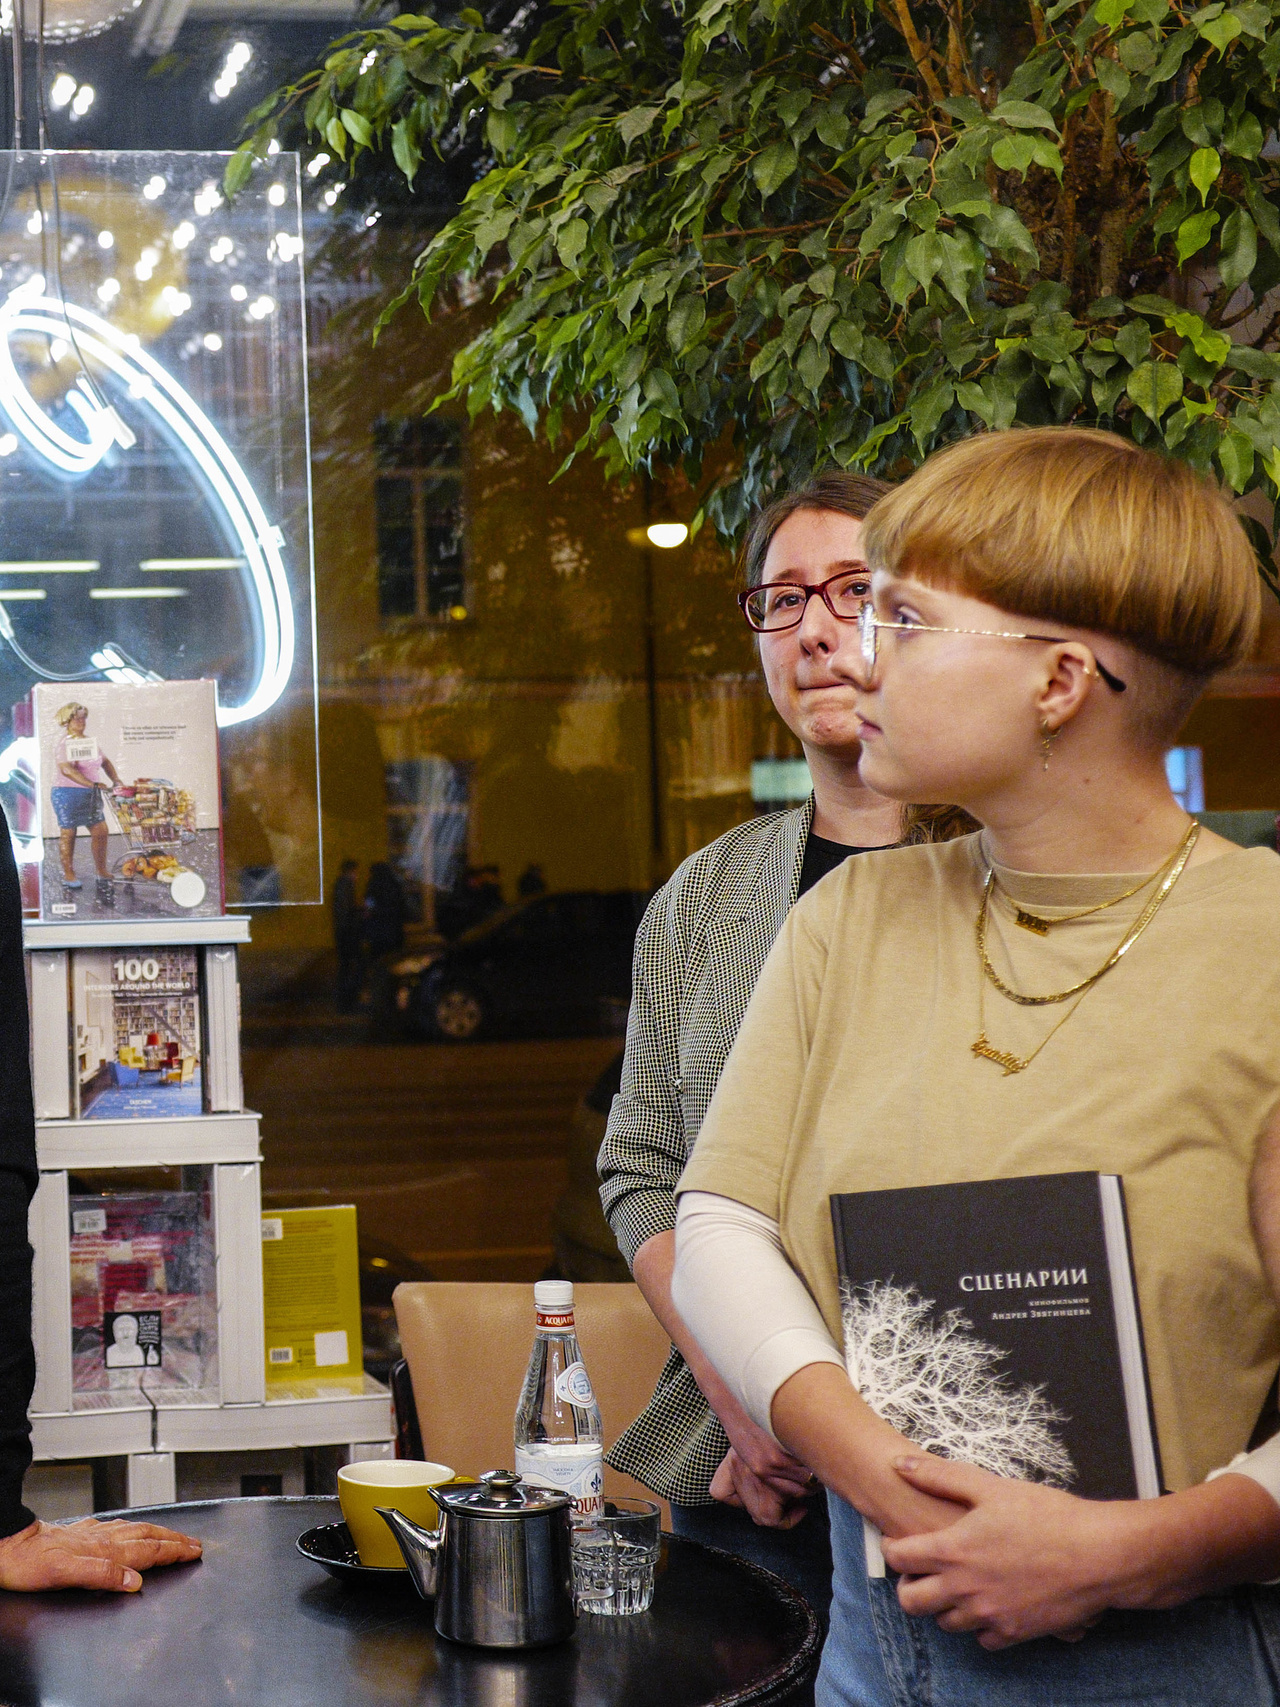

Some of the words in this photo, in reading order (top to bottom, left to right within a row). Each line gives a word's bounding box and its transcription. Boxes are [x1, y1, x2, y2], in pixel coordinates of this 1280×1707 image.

[114, 958, 160, 981] 100
[83, 982, 119, 991] INTERIORS
[120, 982, 151, 991] AROUND
[152, 982, 164, 990] THE
[165, 981, 191, 990] WORLD
[959, 1268, 1089, 1292] СЦЕНАРИИ
[544, 1316, 567, 1327] ACQUA
[576, 1497, 598, 1515] QUA
